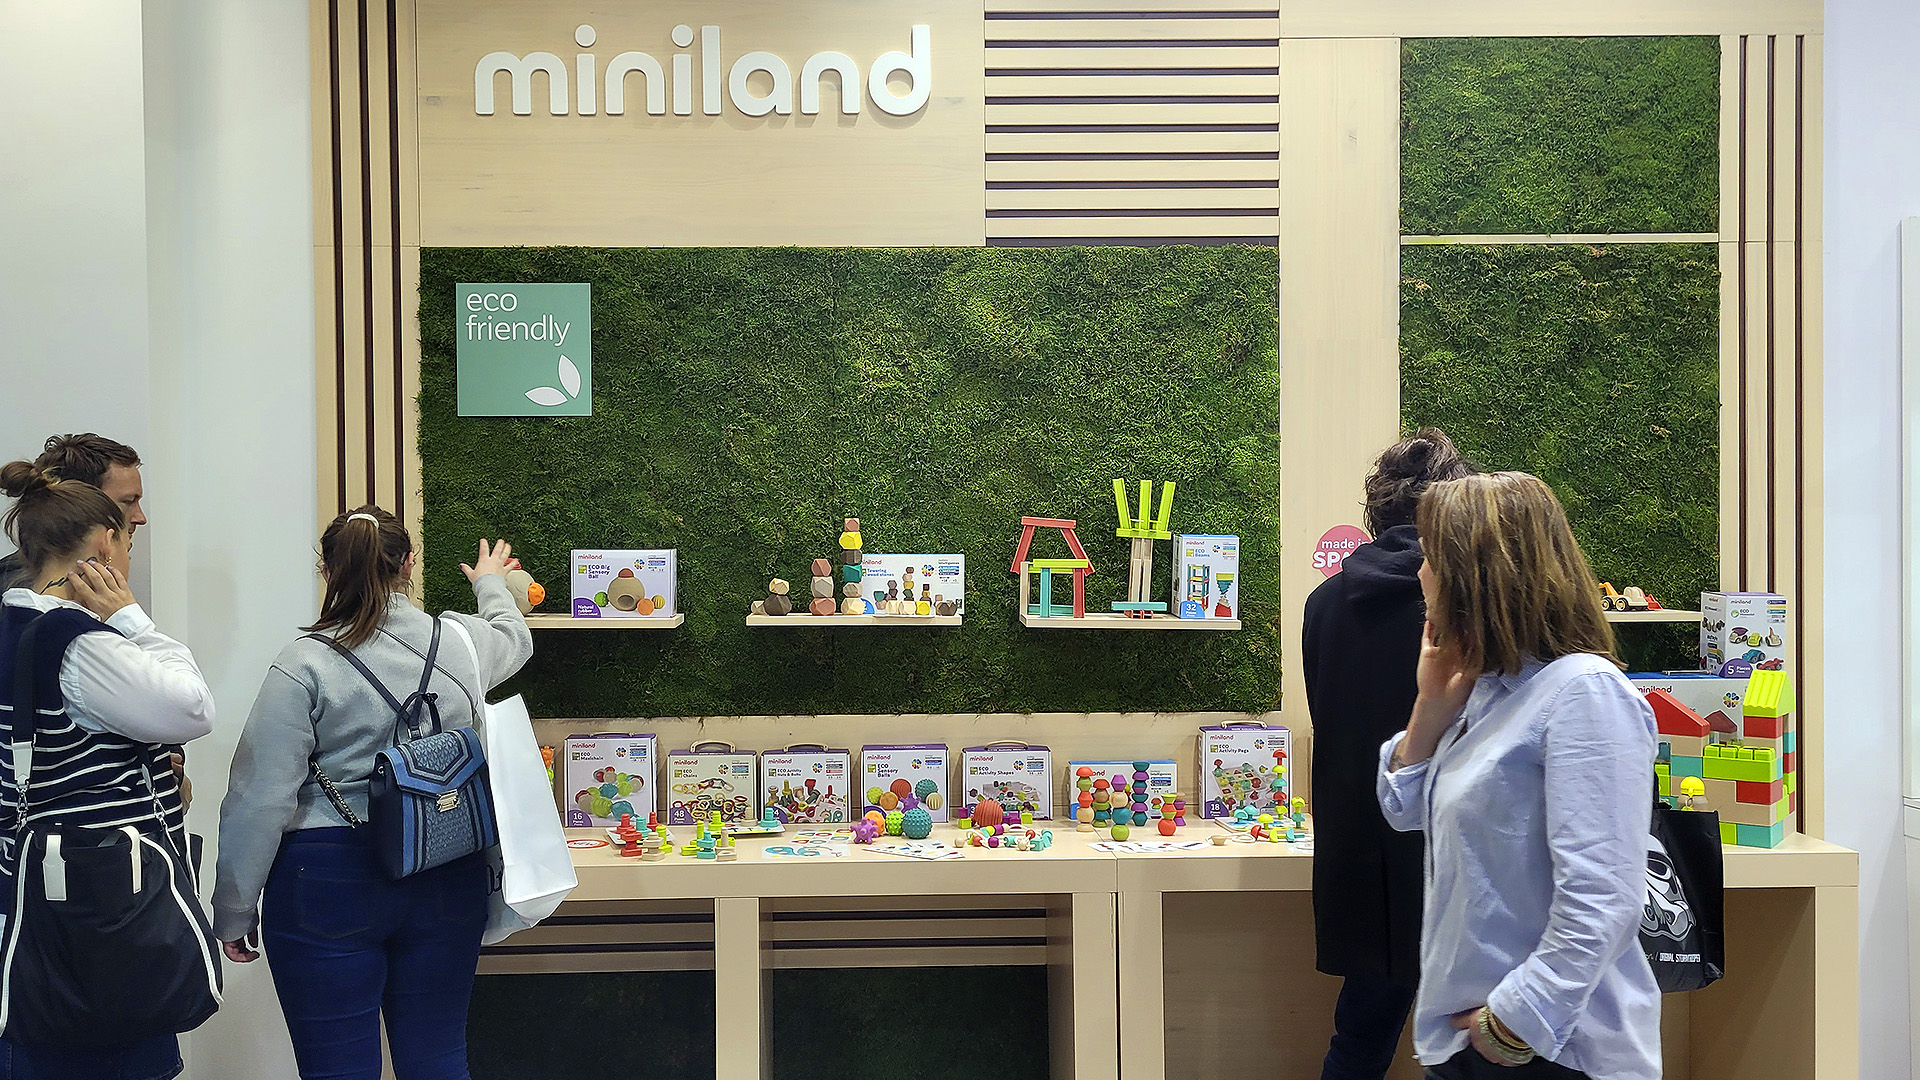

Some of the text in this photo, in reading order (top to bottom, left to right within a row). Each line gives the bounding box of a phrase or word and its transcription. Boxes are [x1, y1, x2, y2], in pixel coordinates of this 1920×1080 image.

[475, 24, 931, 116] miniland
[466, 292, 518, 313] eco
[465, 314, 571, 346] friendly
[1321, 538, 1355, 549] made
[1186, 603, 1197, 611] 32
[1727, 665, 1735, 674] 5
[674, 810, 685, 818] 48
